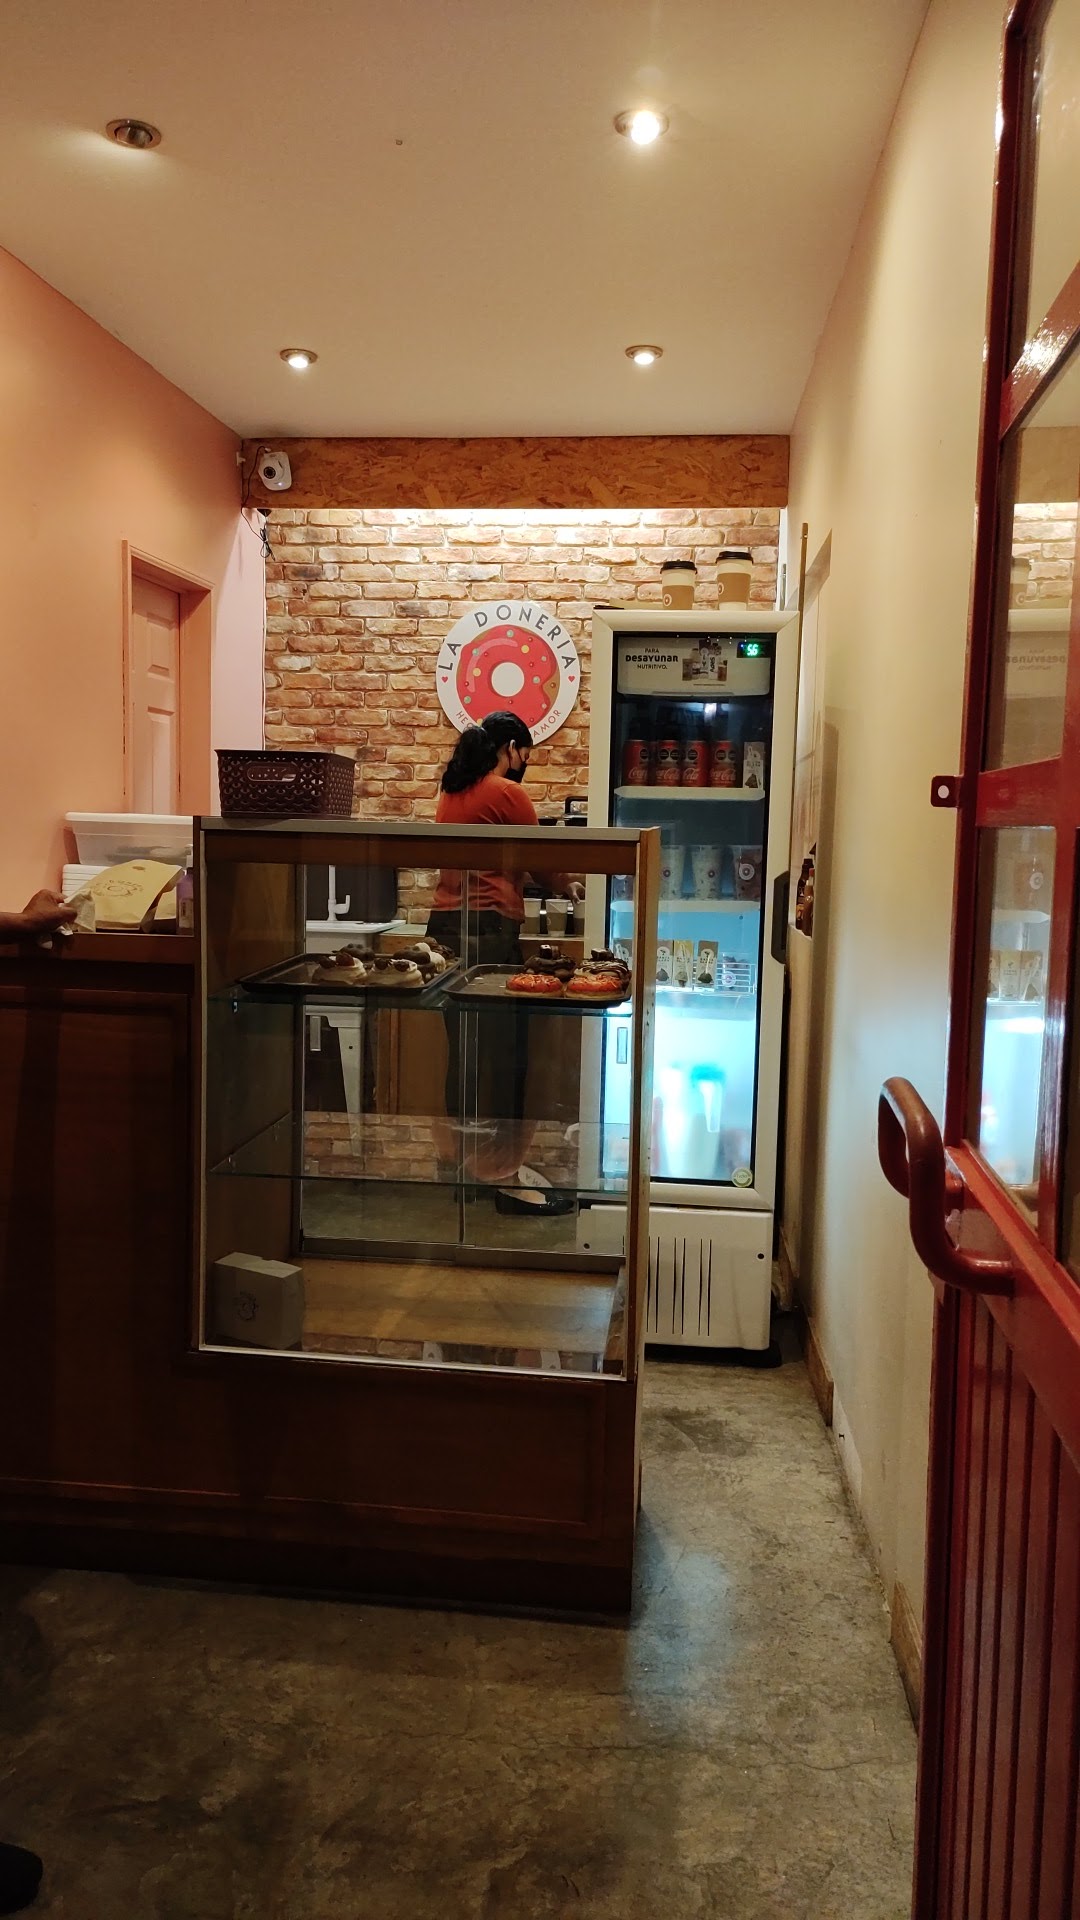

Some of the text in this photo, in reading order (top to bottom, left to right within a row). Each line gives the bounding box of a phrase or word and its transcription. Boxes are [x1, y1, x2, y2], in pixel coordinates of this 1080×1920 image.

[438, 604, 577, 671] LA DONERIA
[533, 709, 561, 738] AMOR
